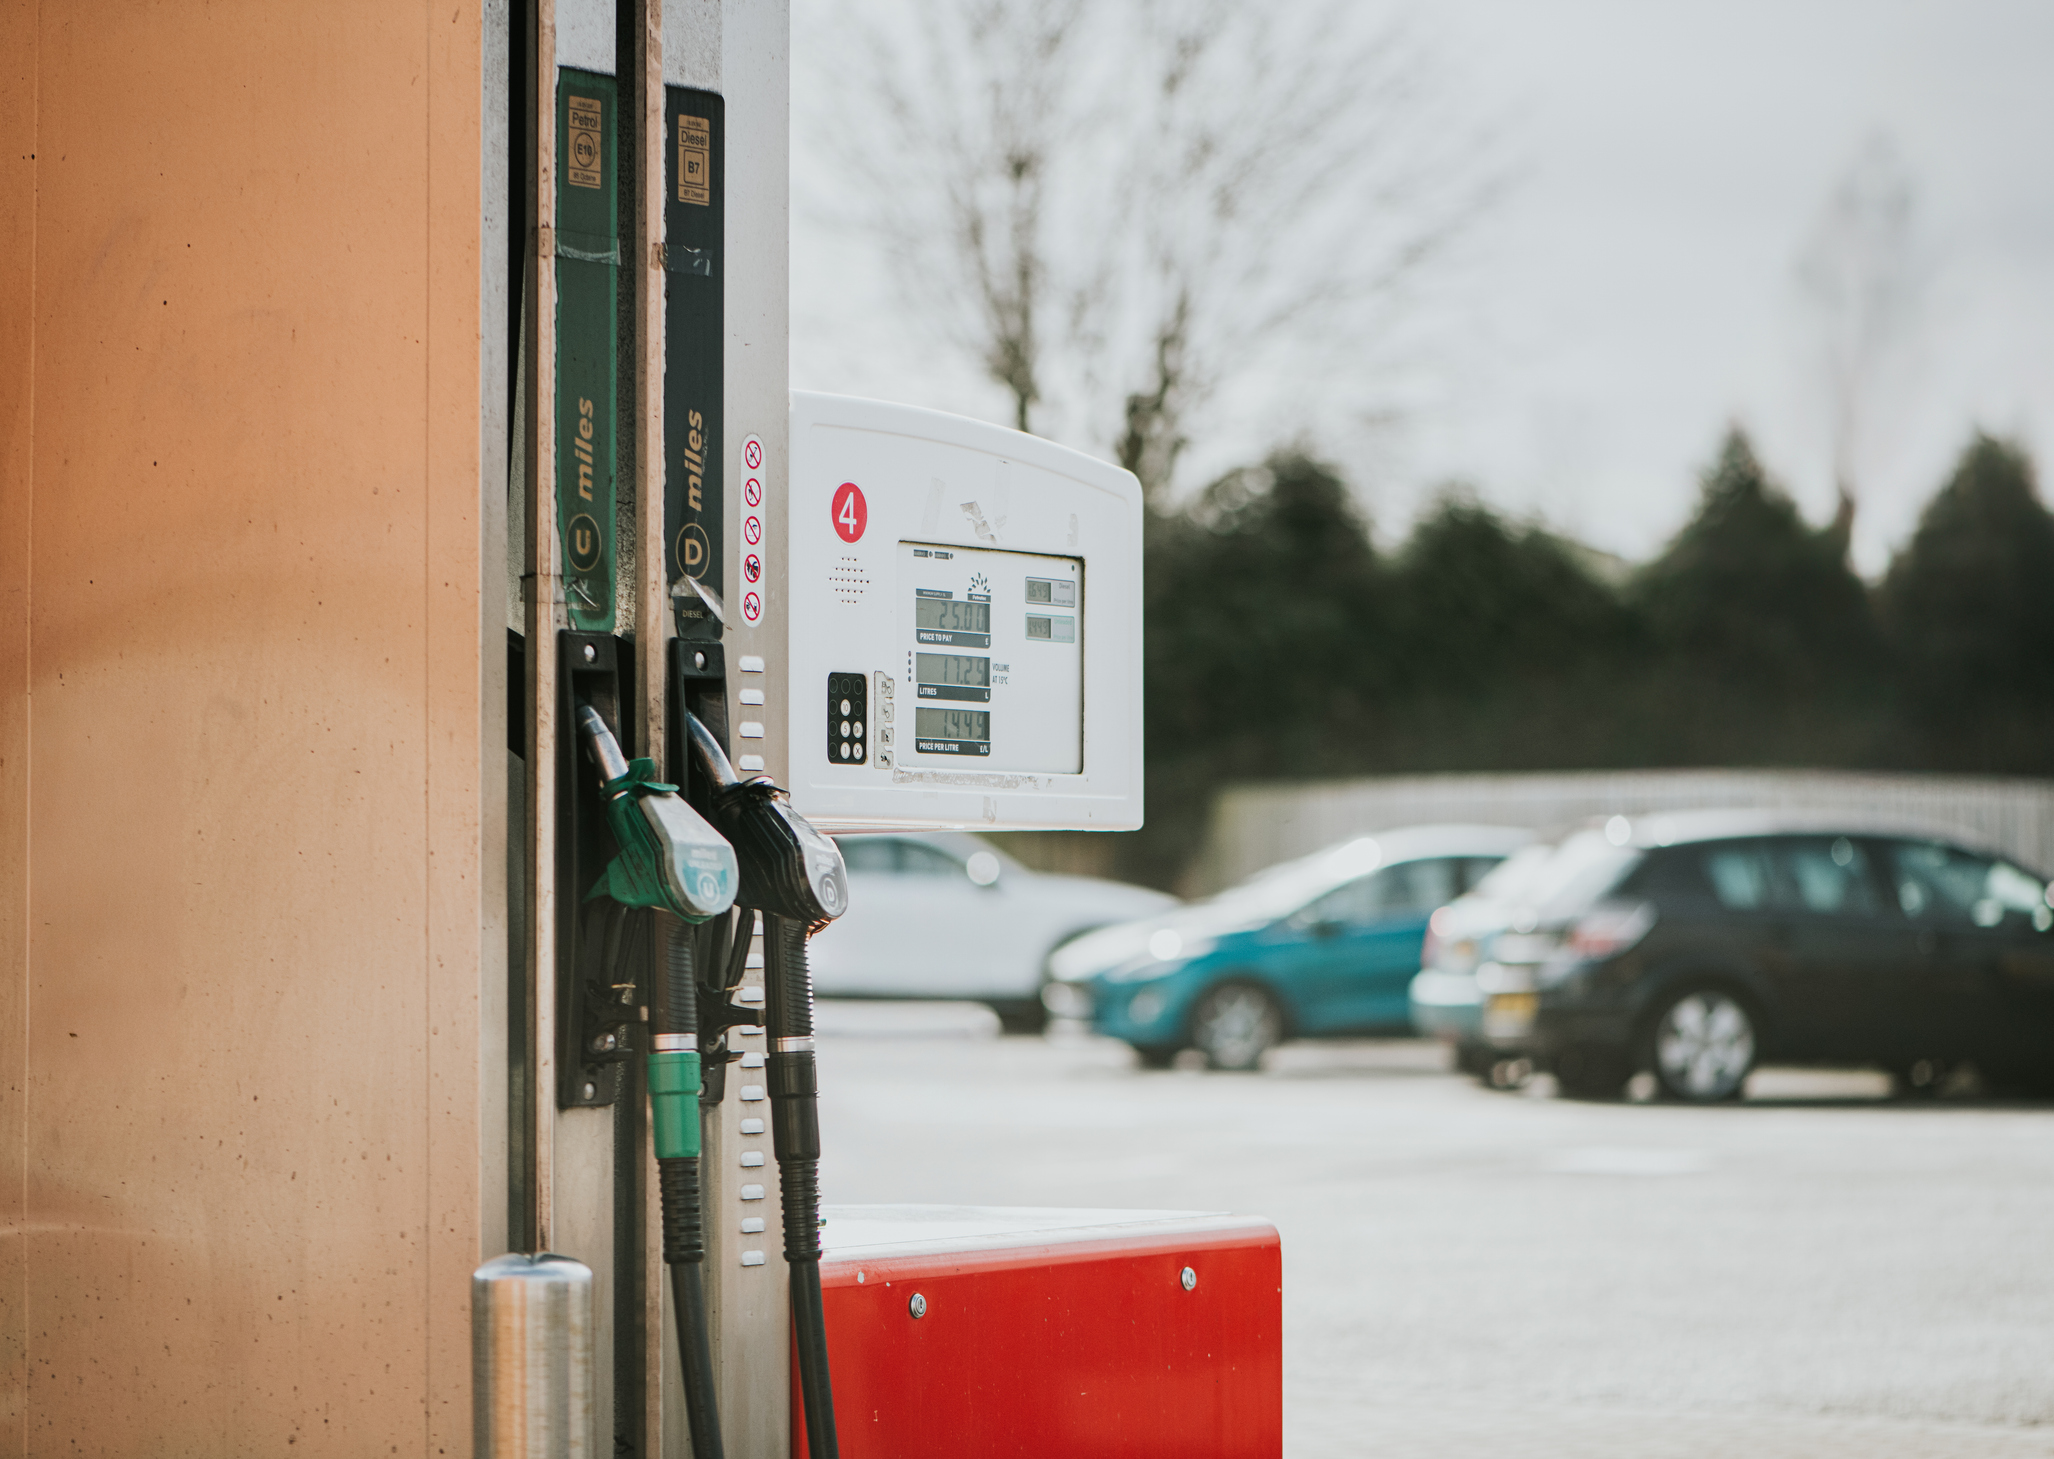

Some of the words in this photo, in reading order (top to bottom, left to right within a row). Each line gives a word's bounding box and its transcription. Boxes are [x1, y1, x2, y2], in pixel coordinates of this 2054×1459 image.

[572, 112, 598, 128] Petrol
[681, 130, 707, 147] Diesel
[577, 143, 593, 156] E10
[688, 161, 700, 174] B7
[575, 397, 594, 502] miles
[684, 409, 703, 513] miles
[838, 492, 857, 534] 4
[684, 538, 703, 565] D
[682, 609, 704, 619] DIESEL
[939, 601, 985, 632] 25.00
[919, 632, 935, 641] PRICE
[935, 634, 942, 642] TO
[942, 634, 953, 643] PAY
[944, 656, 985, 686] 17.25
[992, 663, 1010, 673] VOLUME
[992, 675, 998, 683] AT
[919, 687, 937, 696] LITRES
[944, 710, 985, 740] 1.449
[919, 742, 934, 751] PRICE
[934, 743, 945, 752] PER
[944, 743, 960, 752] LITRE
[702, 881, 715, 898] U
[826, 886, 835, 902] D
